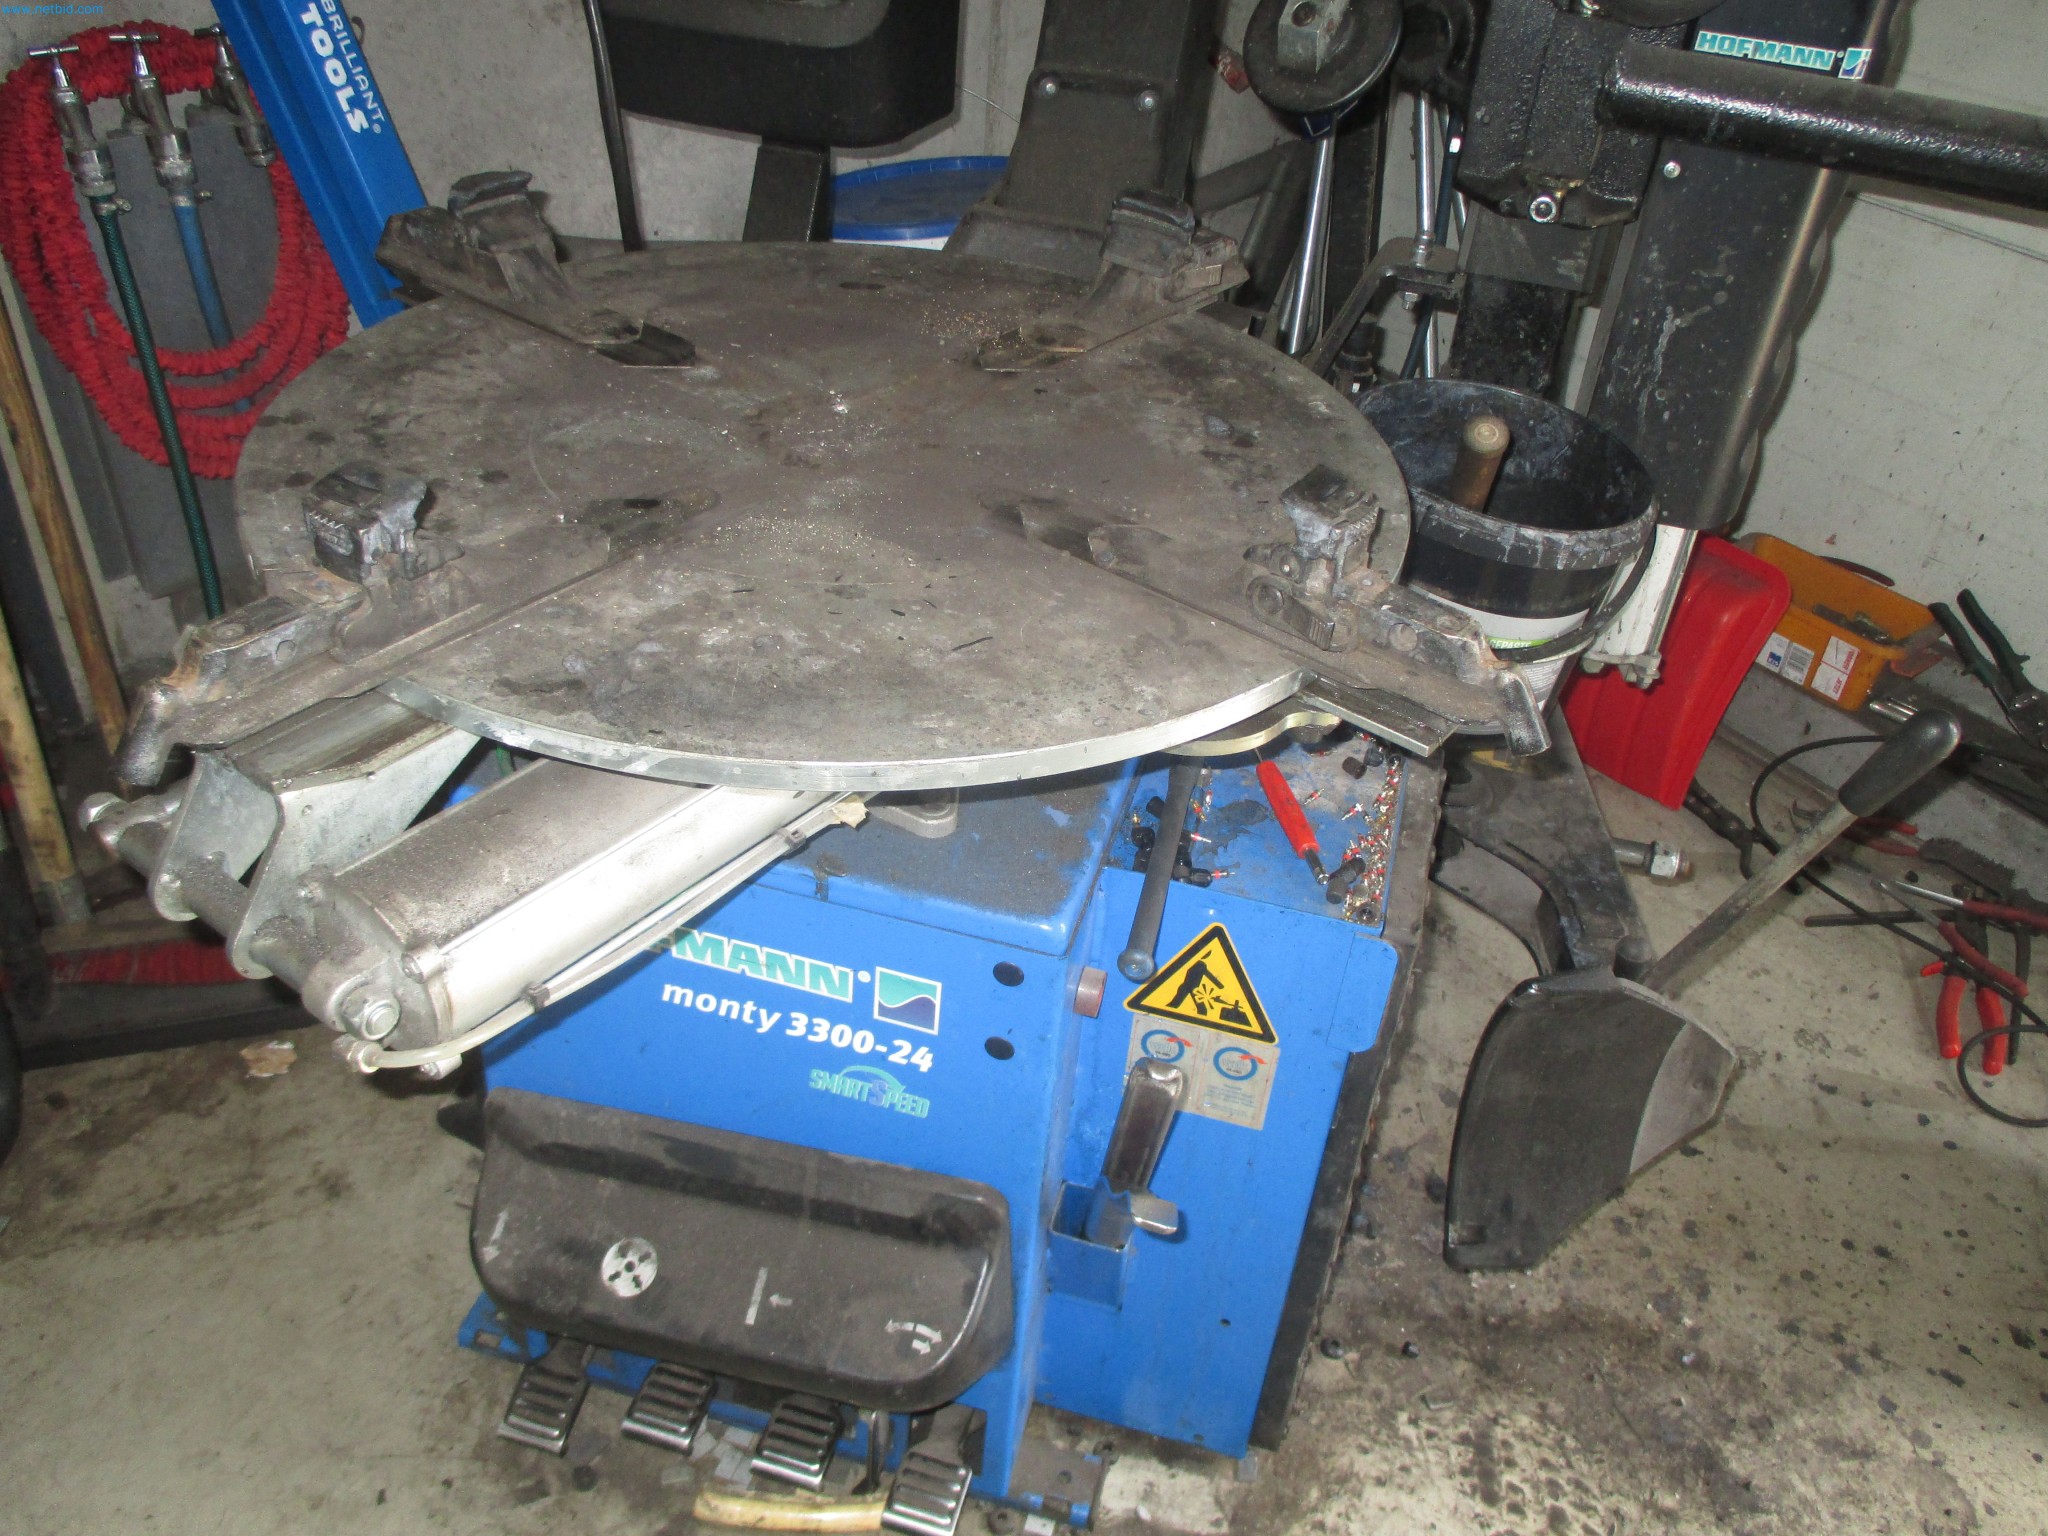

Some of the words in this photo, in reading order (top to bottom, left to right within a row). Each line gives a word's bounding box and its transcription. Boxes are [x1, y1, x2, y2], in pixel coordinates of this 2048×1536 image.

[301, 2, 370, 134] TOOLS
[321, 0, 385, 122] BRILLIANT
[1694, 30, 1836, 71] HOFMANN
[664, 927, 853, 1003] MANN
[661, 983, 781, 1033] monty
[786, 1011, 934, 1072] 3300-24
